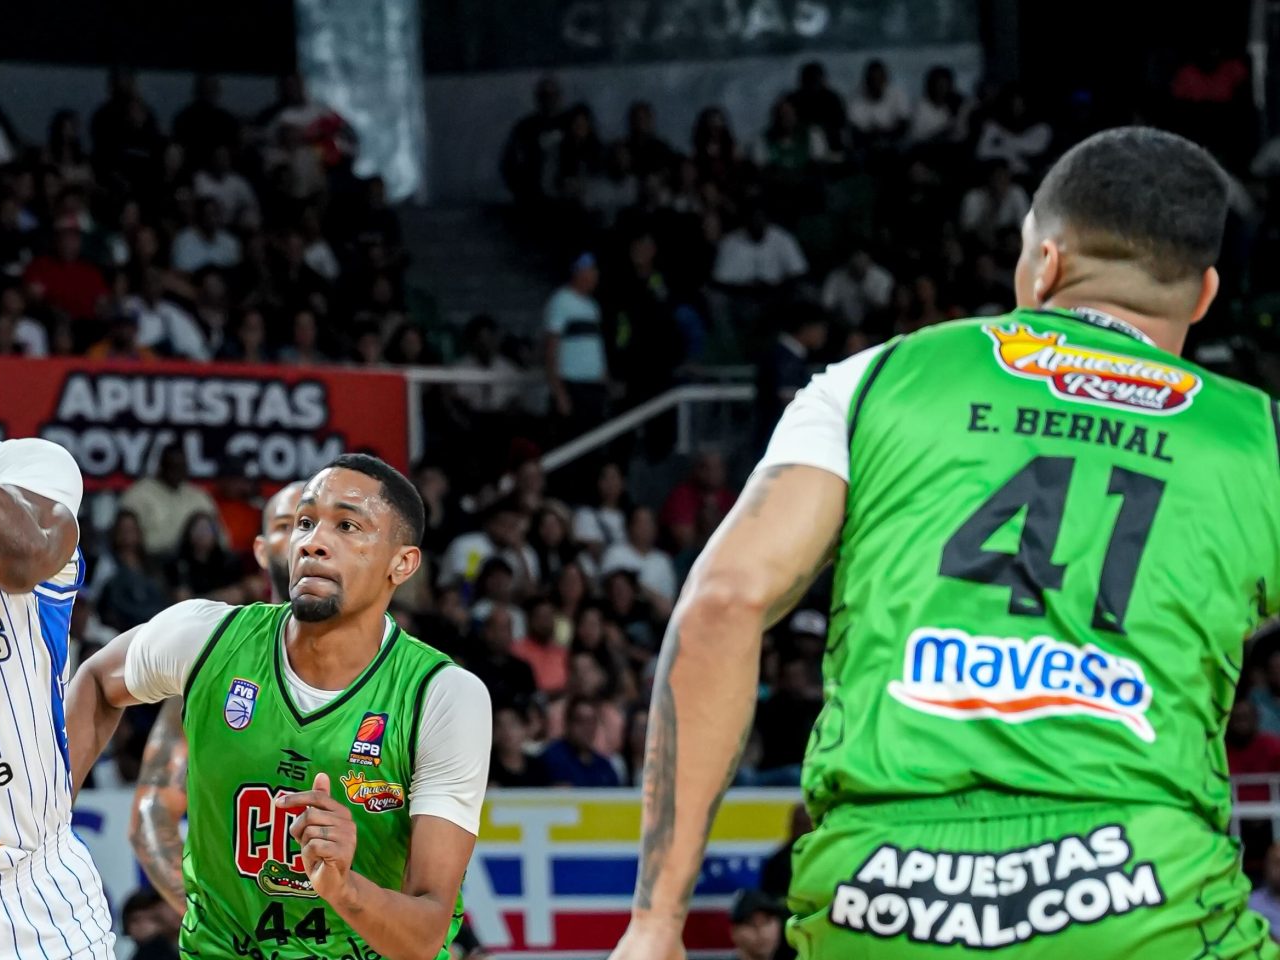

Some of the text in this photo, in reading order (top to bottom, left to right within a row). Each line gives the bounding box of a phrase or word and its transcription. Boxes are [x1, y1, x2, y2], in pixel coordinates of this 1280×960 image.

[1014, 345, 1184, 385] Apuestas
[1063, 372, 1172, 405] Royal
[56, 375, 327, 430] APUESTAS
[967, 402, 1174, 463] E. BERNAL
[940, 455, 1168, 635] 41
[233, 684, 254, 699] FVB
[911, 636, 1149, 708] mavesa
[352, 741, 380, 756] SPB
[858, 826, 1132, 897] APUESTAS
[255, 900, 331, 945] 44
[831, 865, 1163, 948] ROYAL.COM
